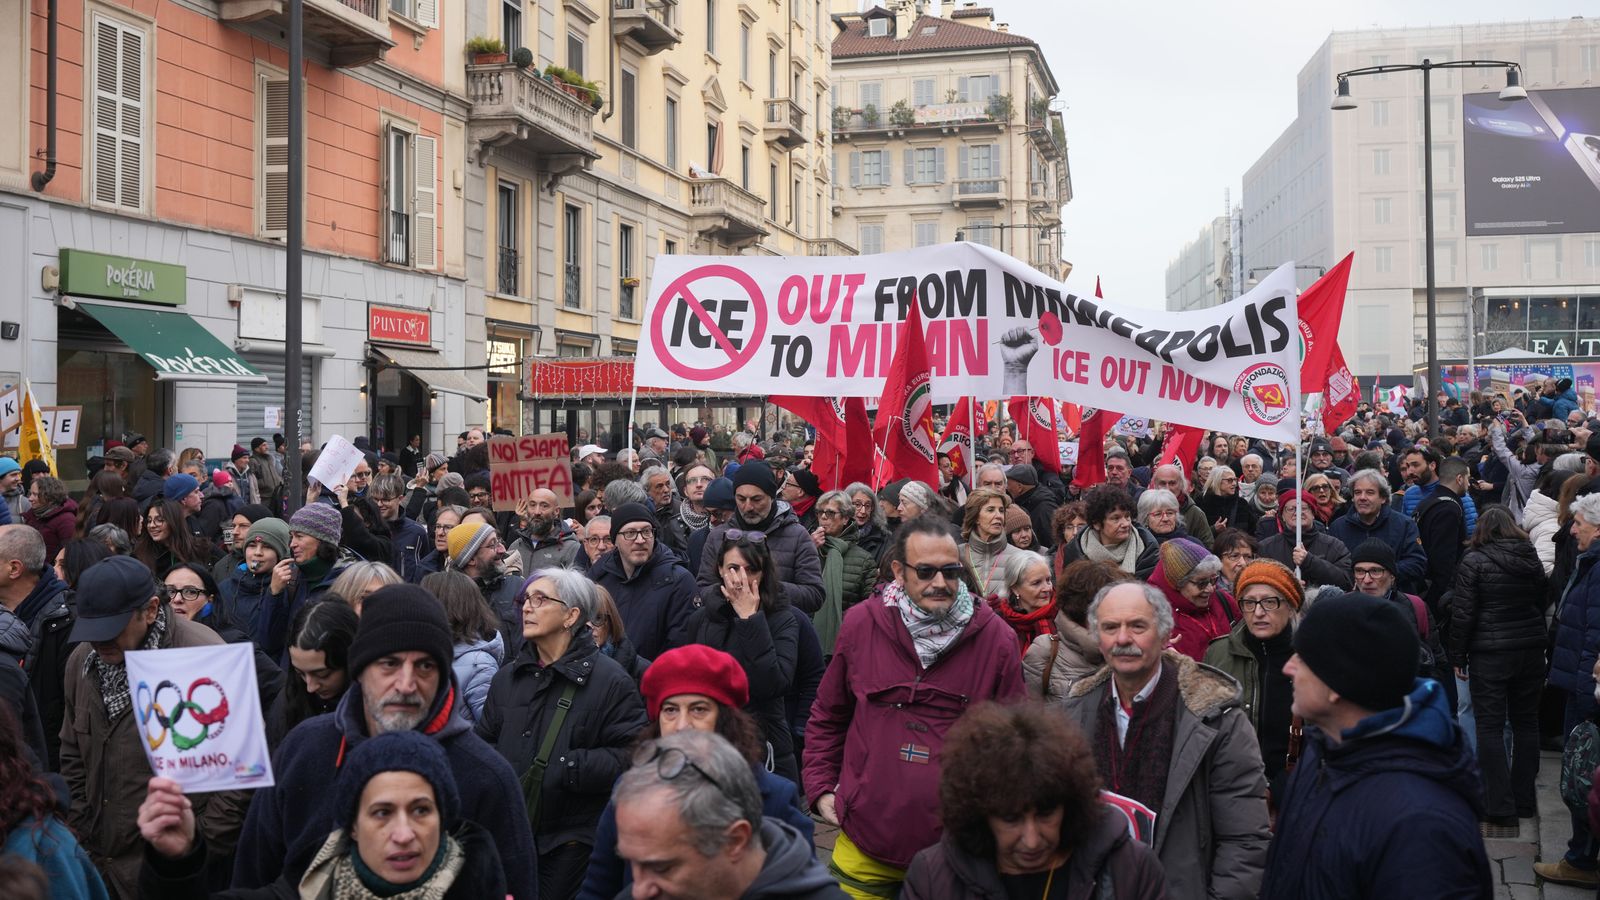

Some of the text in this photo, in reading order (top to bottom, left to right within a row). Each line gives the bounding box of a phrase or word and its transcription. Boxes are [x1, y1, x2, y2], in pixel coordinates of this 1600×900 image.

[106, 260, 155, 291] POKÉRIA
[777, 273, 866, 326] OUT
[874, 269, 987, 322] FROM
[10, 324, 16, 337] 7
[373, 315, 411, 334] PUNTO
[670, 298, 749, 350] ICE
[770, 335, 813, 378] TO
[911, 372, 930, 385] EURO
[1053, 347, 1231, 409] ICE OUT NOW
[491, 438, 570, 462] NOI SIAMO
[910, 437, 934, 461] COMUNIS
[179, 753, 232, 769] MILANO.
